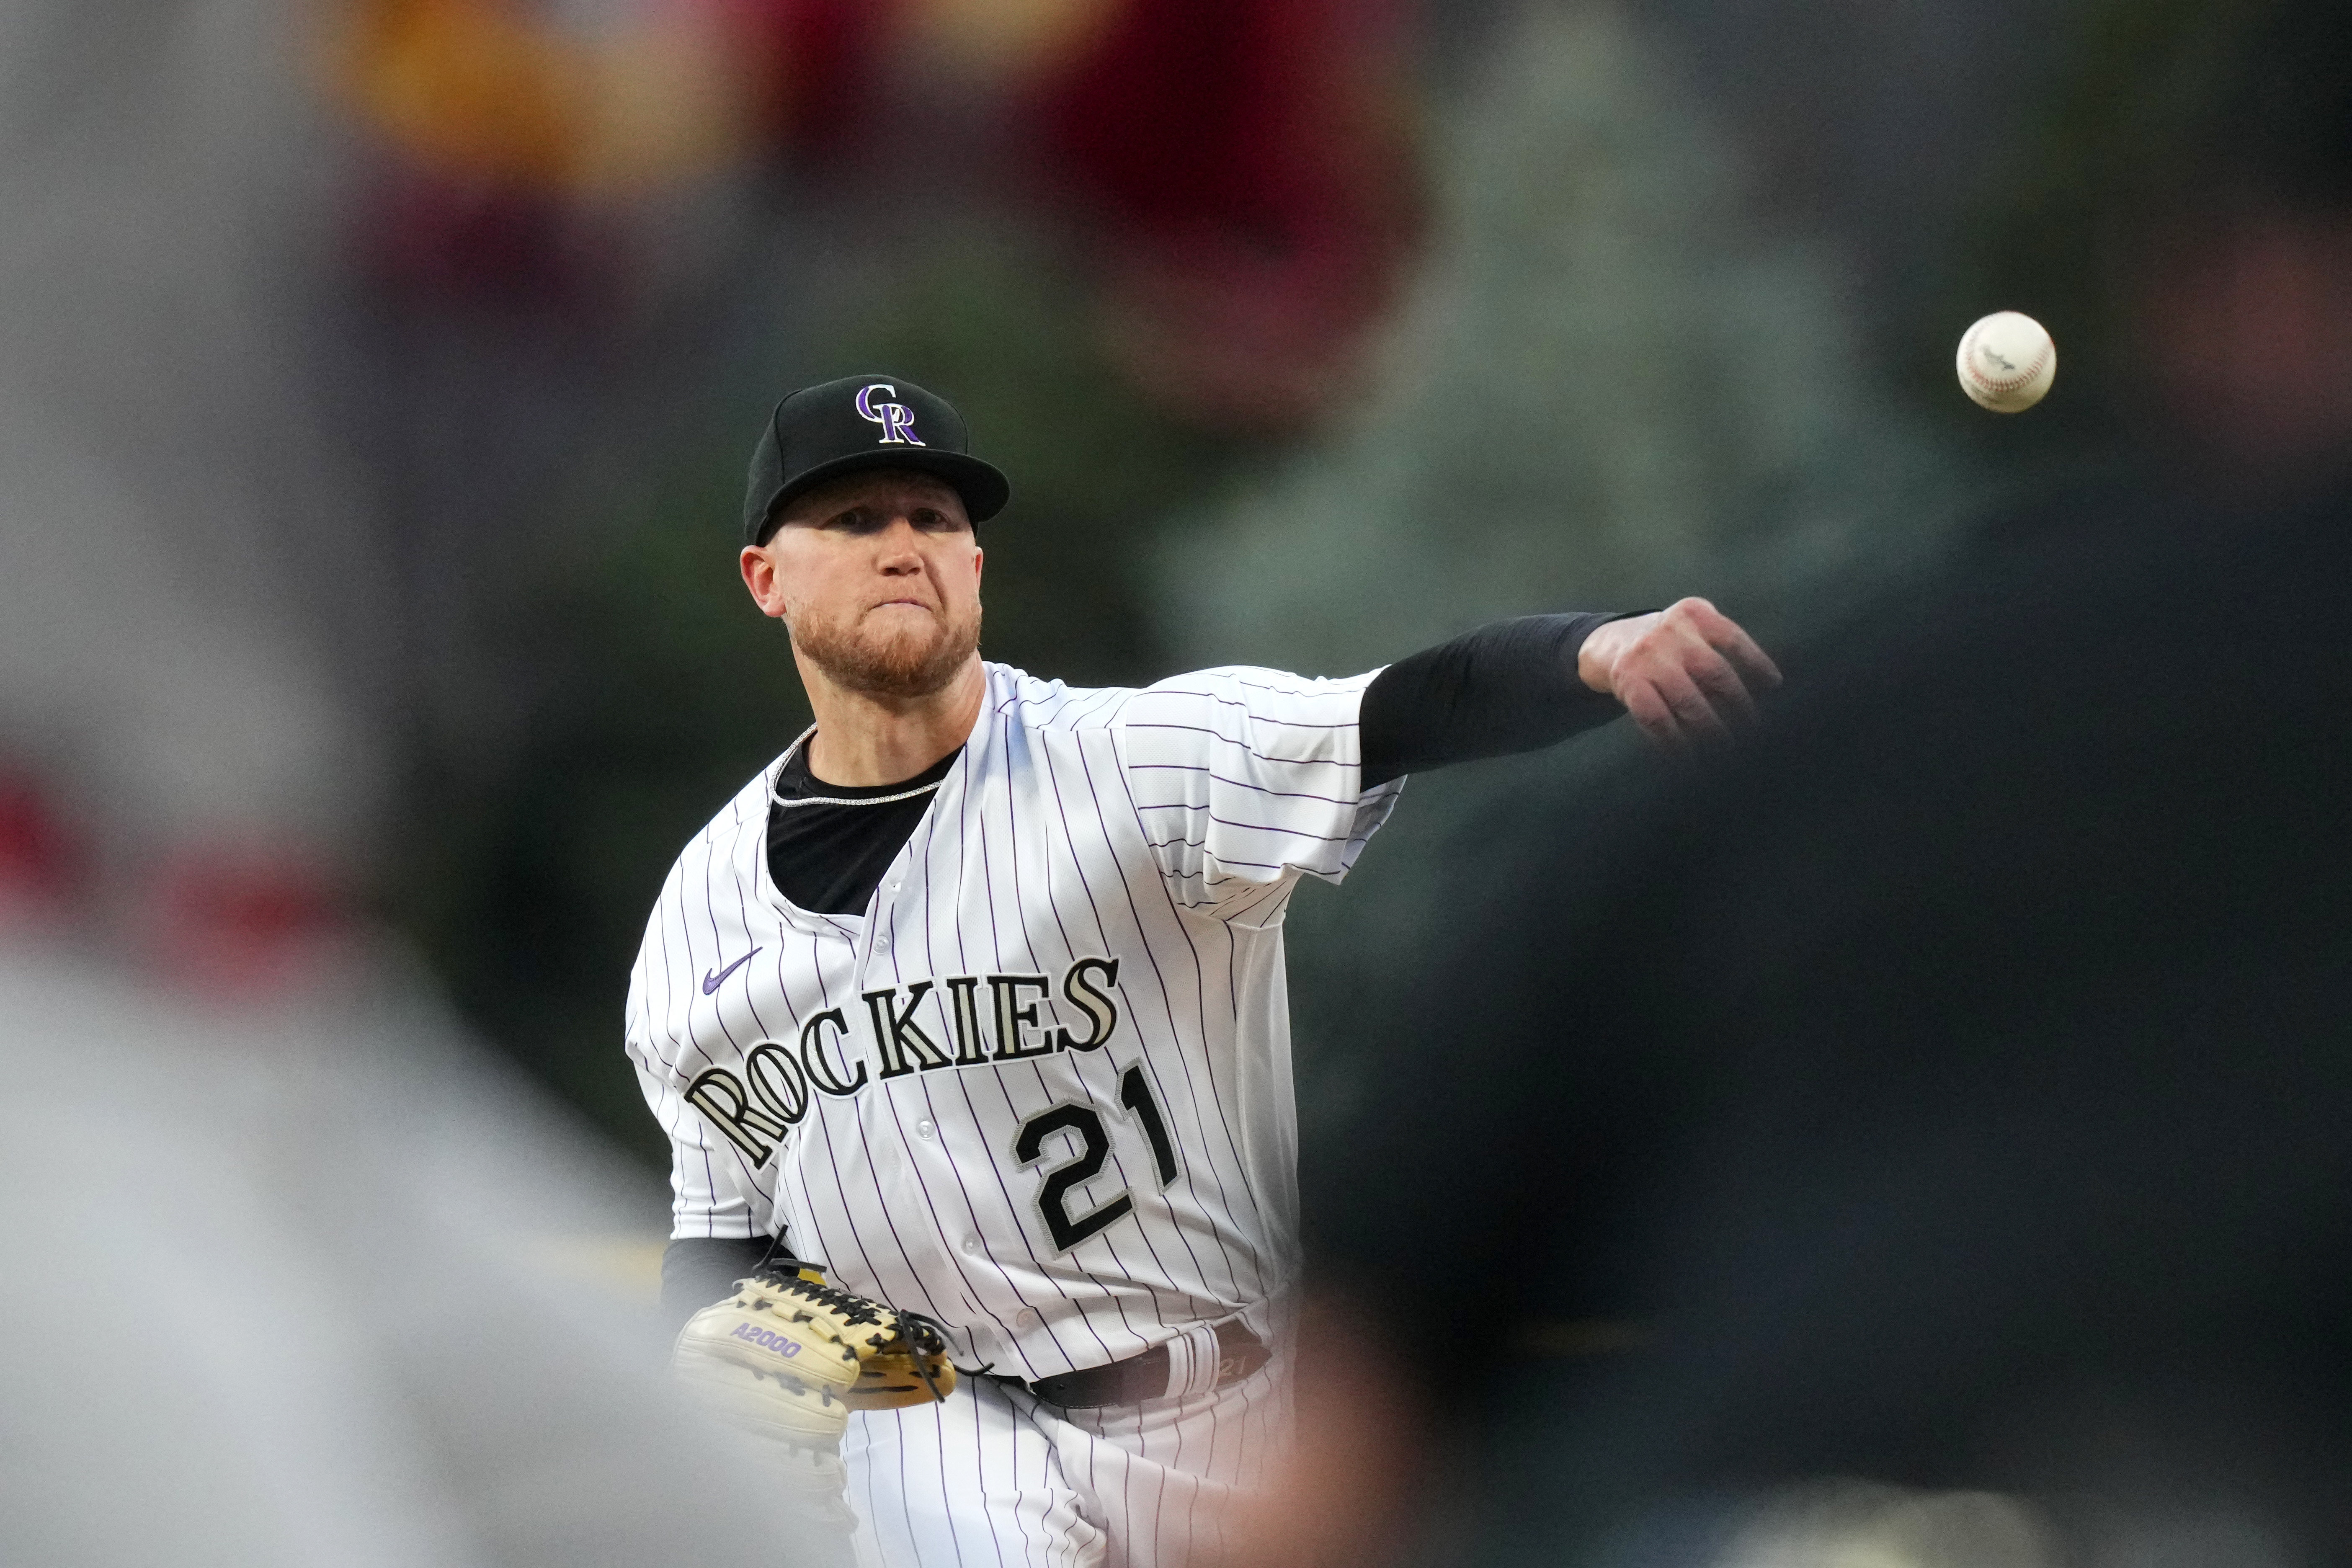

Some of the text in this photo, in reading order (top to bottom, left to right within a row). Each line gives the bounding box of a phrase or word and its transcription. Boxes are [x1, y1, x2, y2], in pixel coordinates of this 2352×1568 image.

[683, 956, 1119, 1170] ROCKIES
[1011, 1057, 1181, 1259] 21
[730, 1322, 802, 1359] A2000
[1219, 1355, 1246, 1376] 21
